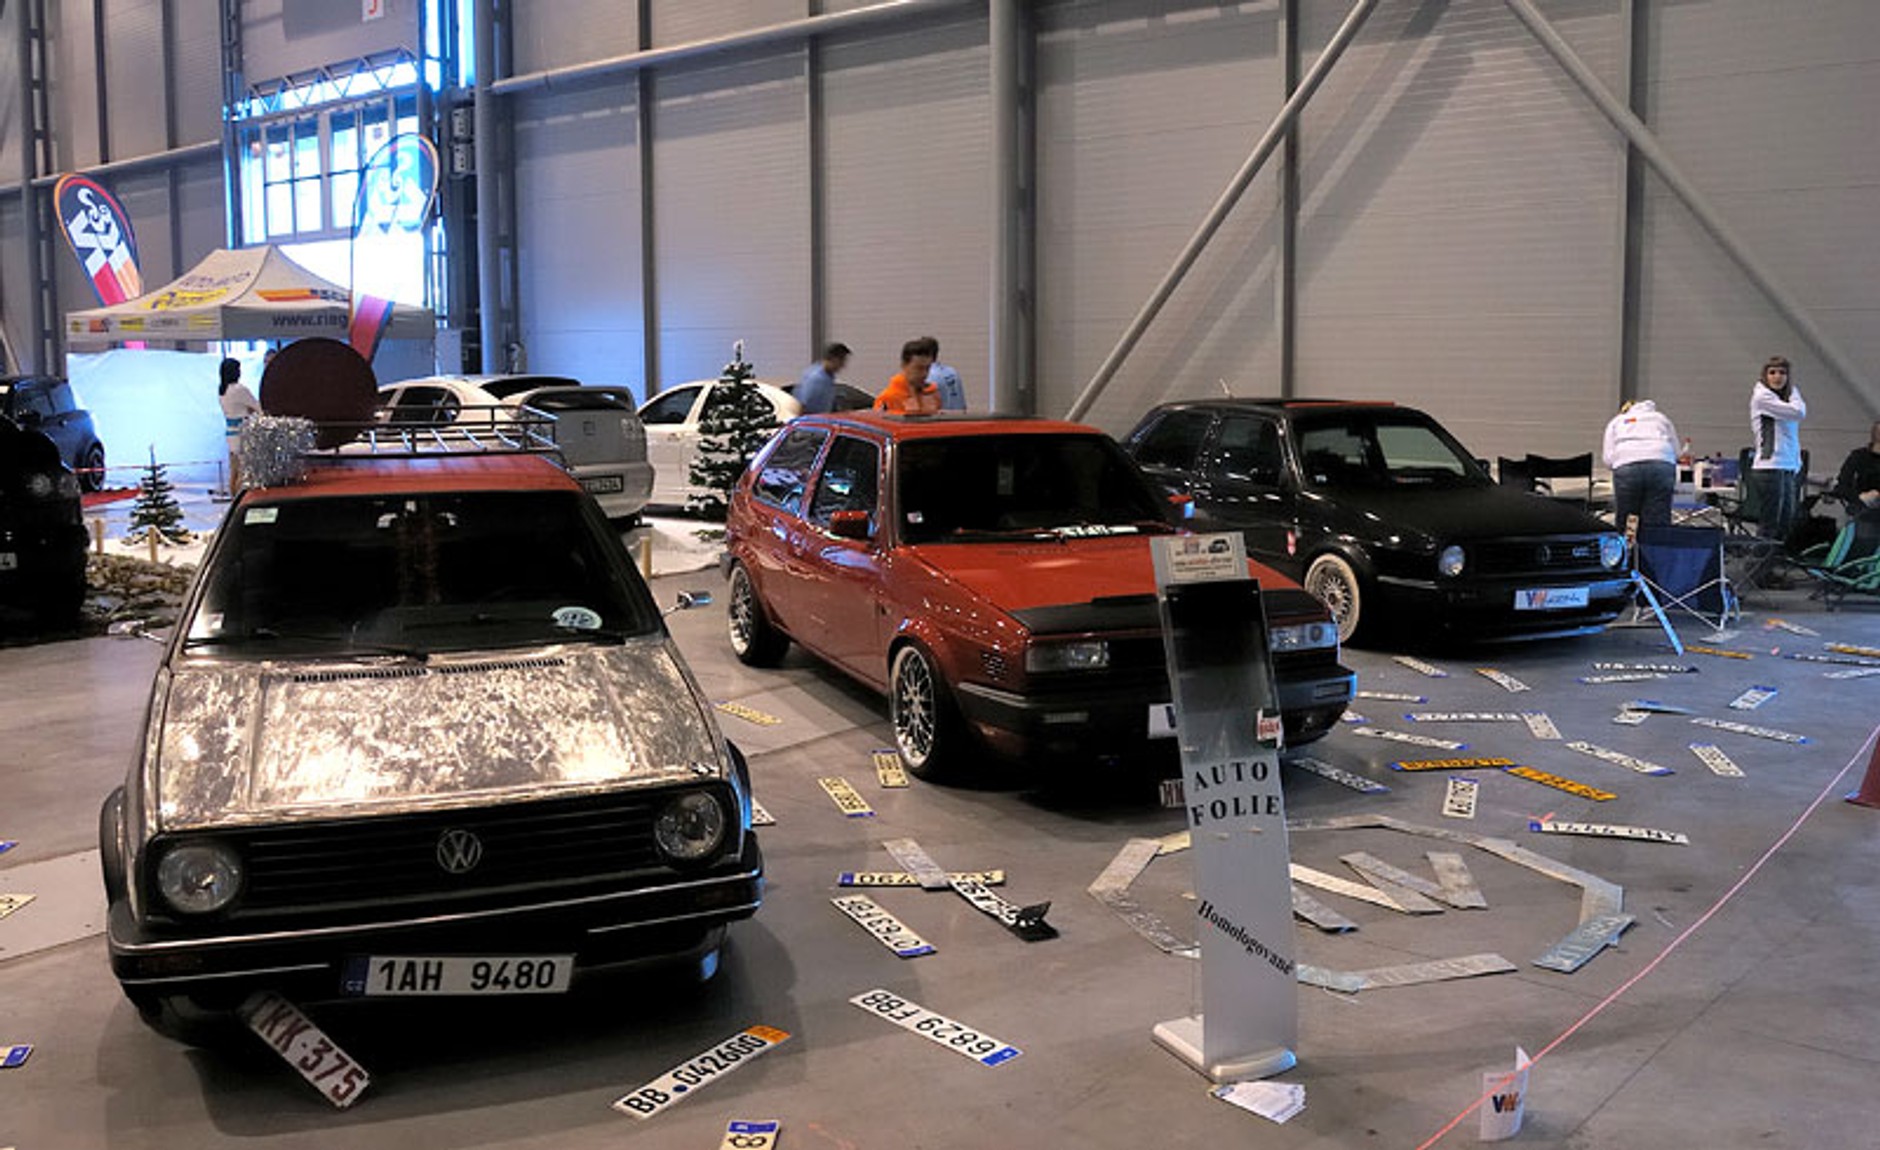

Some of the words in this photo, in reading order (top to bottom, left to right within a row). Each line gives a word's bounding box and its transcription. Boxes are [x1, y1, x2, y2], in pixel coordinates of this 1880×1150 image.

[1194, 761, 1269, 791] AUTO
[1191, 795, 1281, 826] FOLIE
[437, 829, 482, 874] VW
[1198, 900, 1295, 976] Homologované
[379, 960, 443, 991] 1AH
[470, 960, 556, 990] 9480
[915, 1017, 996, 1055] 6829
[623, 1088, 670, 1113] BB
